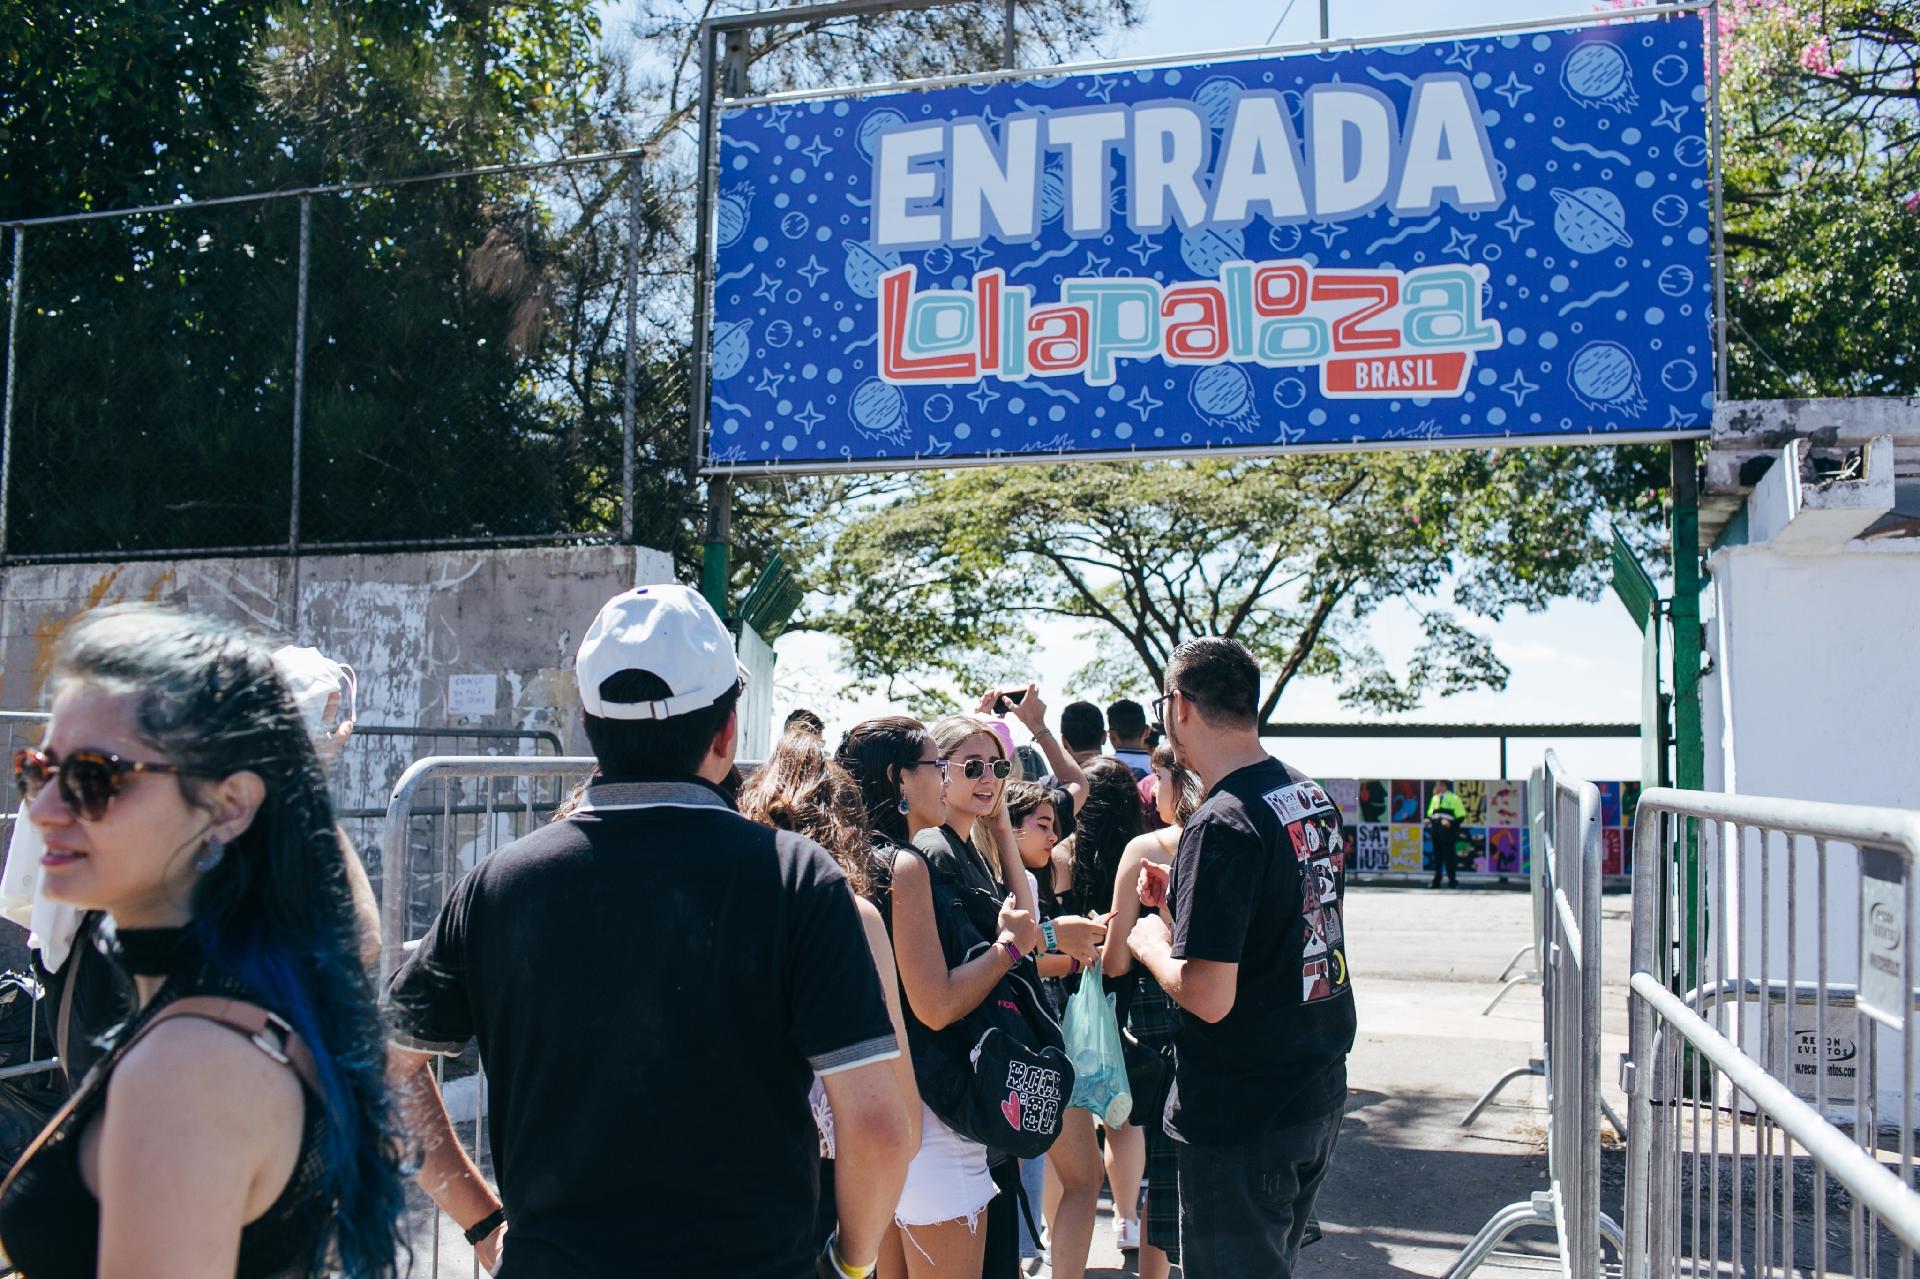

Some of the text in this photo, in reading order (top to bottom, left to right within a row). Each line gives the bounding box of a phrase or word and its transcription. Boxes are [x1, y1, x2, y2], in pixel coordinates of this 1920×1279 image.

[876, 79, 1499, 247] ENTRADA
[1355, 358, 1438, 389] BRASIL
[1798, 1045, 1848, 1056] EVETOS
[1802, 1036, 1840, 1047] REON
[1006, 1060, 1062, 1100] ROCK
